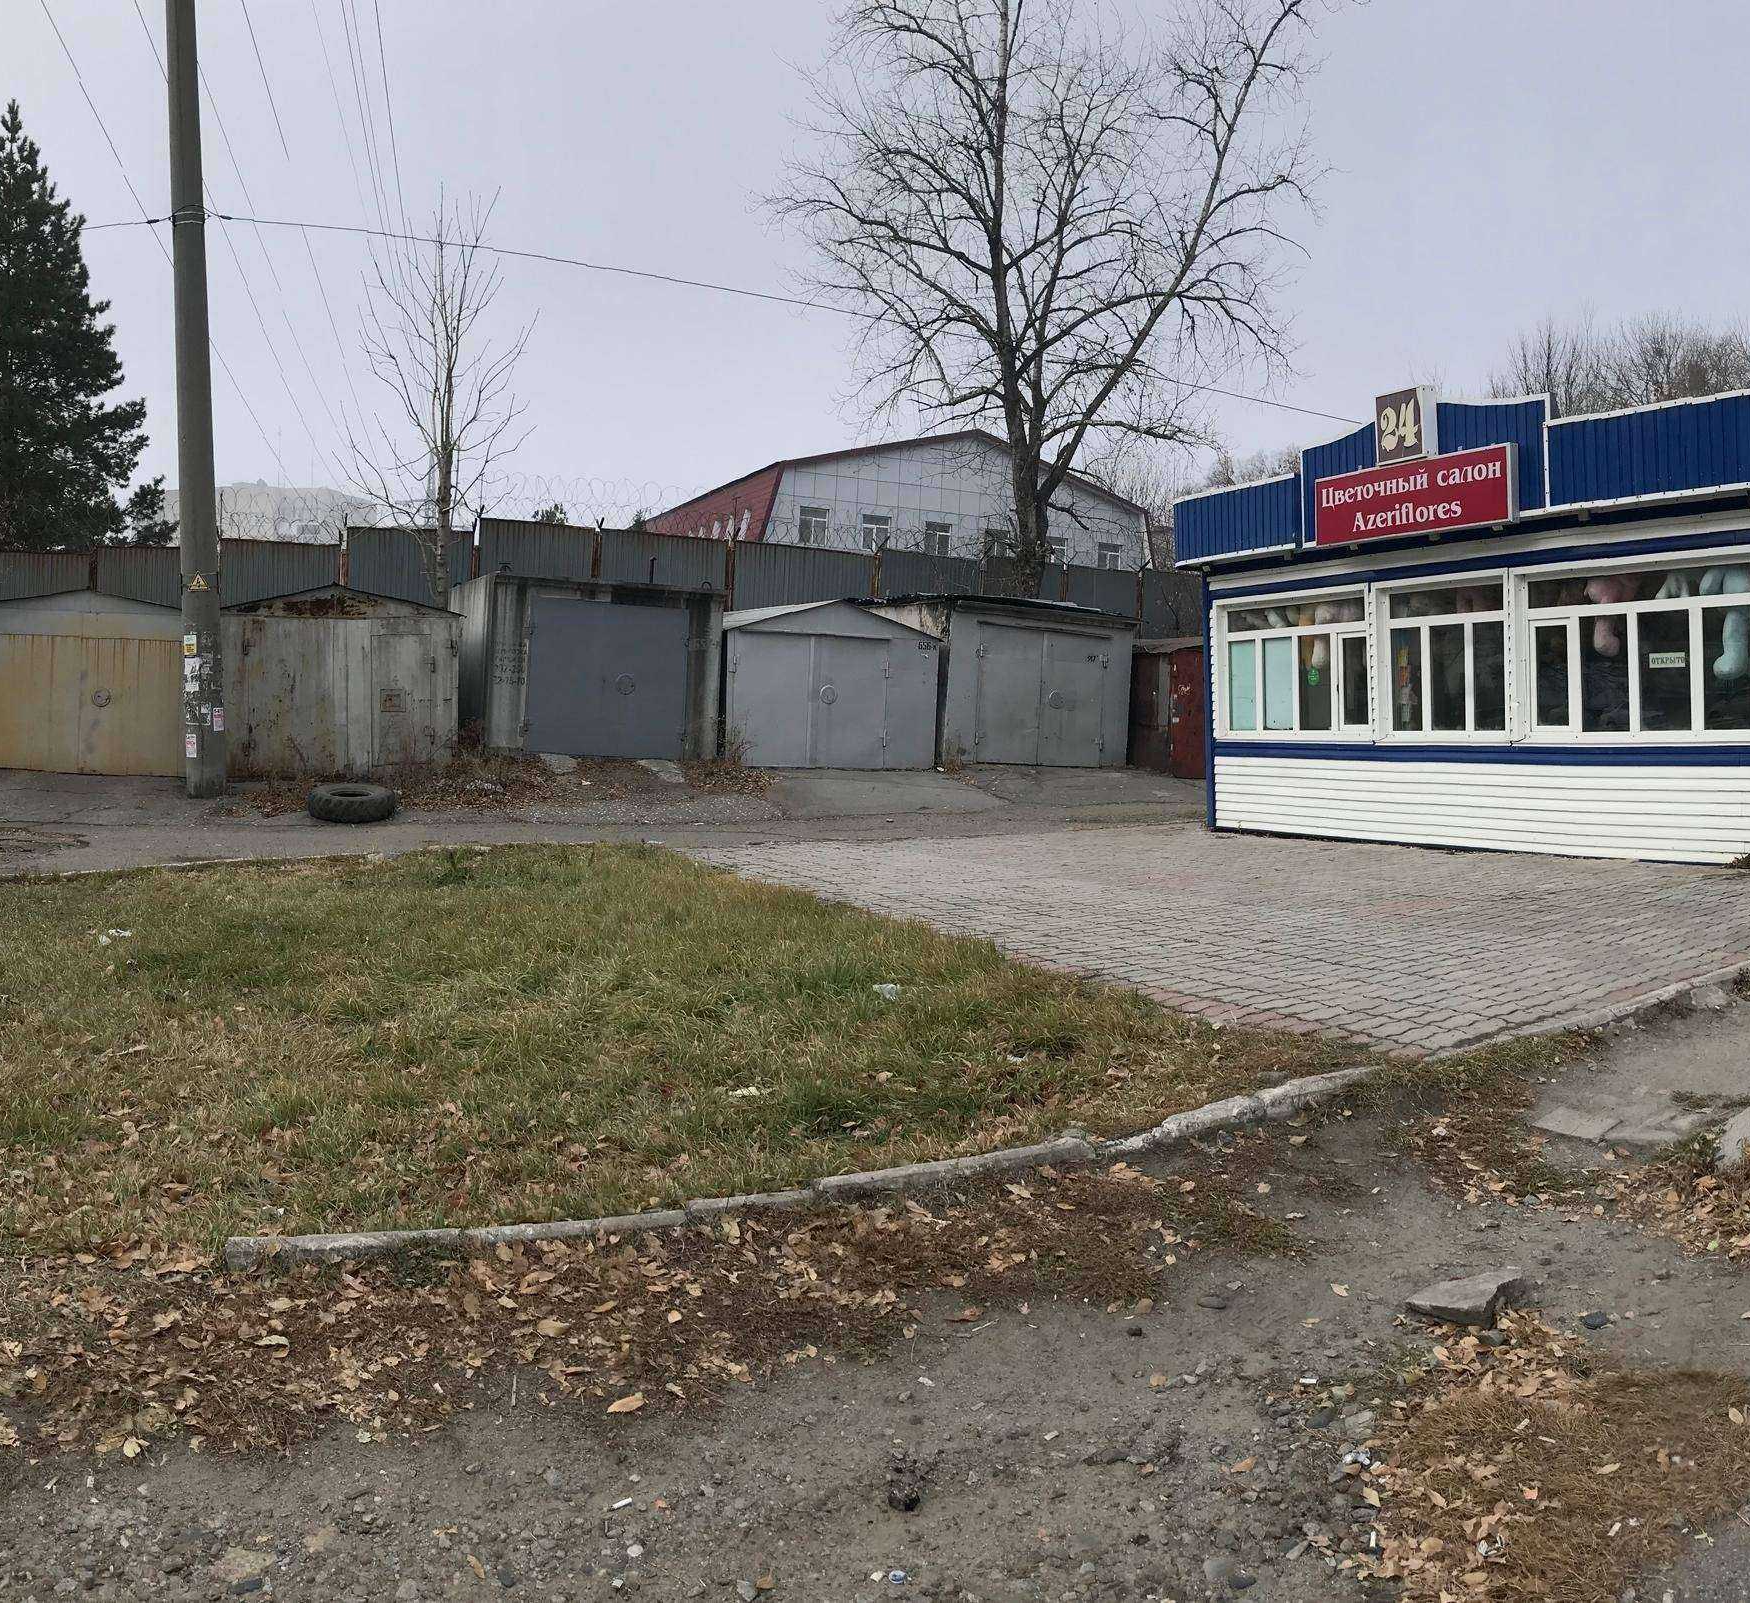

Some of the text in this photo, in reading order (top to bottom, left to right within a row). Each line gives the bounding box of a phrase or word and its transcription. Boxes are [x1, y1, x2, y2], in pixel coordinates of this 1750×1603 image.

[1380, 398, 1420, 452] 24
[1321, 460, 1502, 510] Цветочный салон
[1352, 500, 1462, 533] Azeriflores
[1651, 656, 1686, 665] ОТКРЫТО
